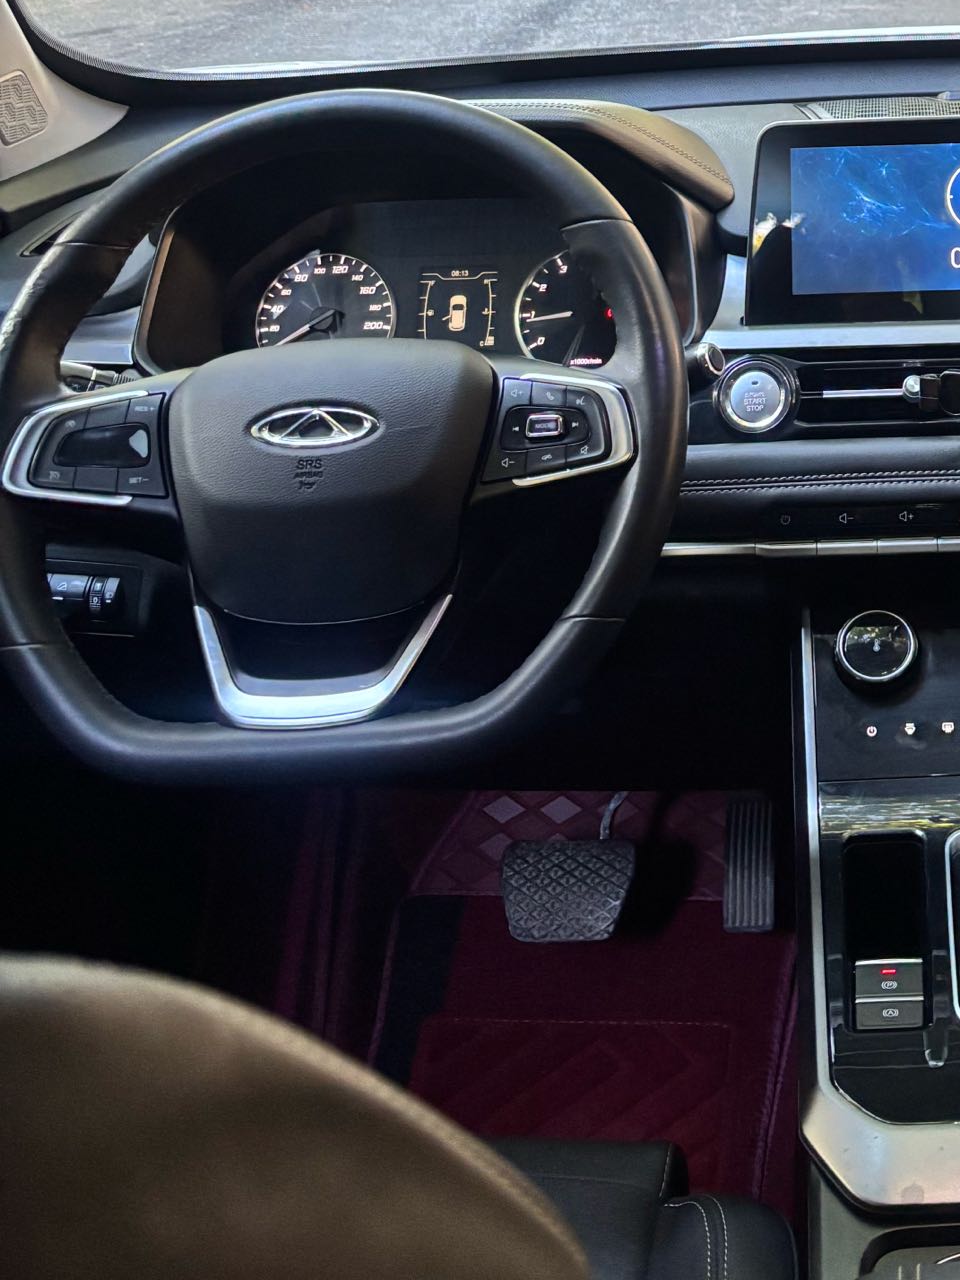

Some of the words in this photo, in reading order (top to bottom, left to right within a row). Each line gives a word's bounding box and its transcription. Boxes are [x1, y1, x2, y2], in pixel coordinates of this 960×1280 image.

[313, 267, 326, 275] 100
[332, 265, 349, 275] 120
[559, 265, 568, 274] 3
[294, 274, 308, 282] 80
[351, 274, 364, 282] 140
[359, 286, 377, 295] 160
[539, 283, 547, 292] 2
[270, 305, 284, 314] 40
[531, 310, 536, 319] 1
[363, 321, 383, 330] 200
[536, 336, 546, 345] 0
[743, 397, 767, 406] START
[296, 459, 322, 469] SRS
